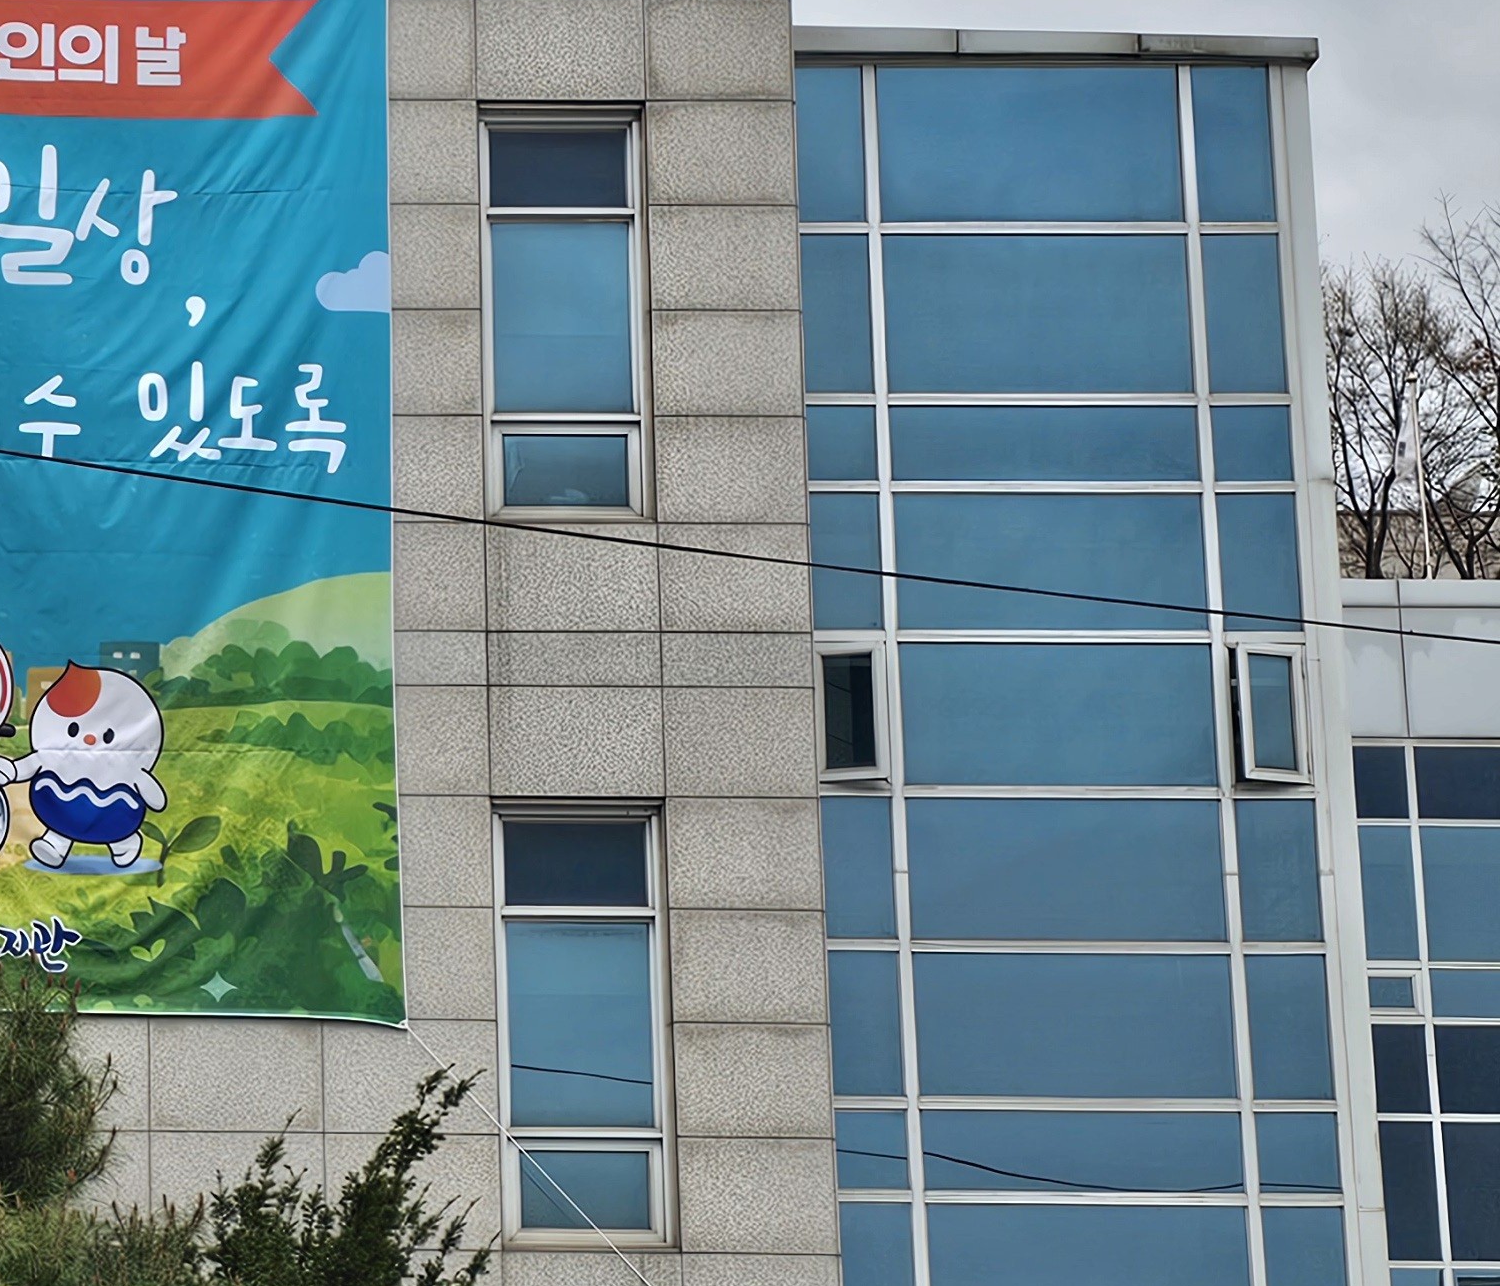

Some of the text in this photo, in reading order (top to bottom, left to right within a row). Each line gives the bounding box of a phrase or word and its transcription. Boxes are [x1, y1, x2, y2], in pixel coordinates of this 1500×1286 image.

[135, 26, 187, 86] 날
[18, 374, 81, 459] 수
[138, 361, 348, 474] 있도록
